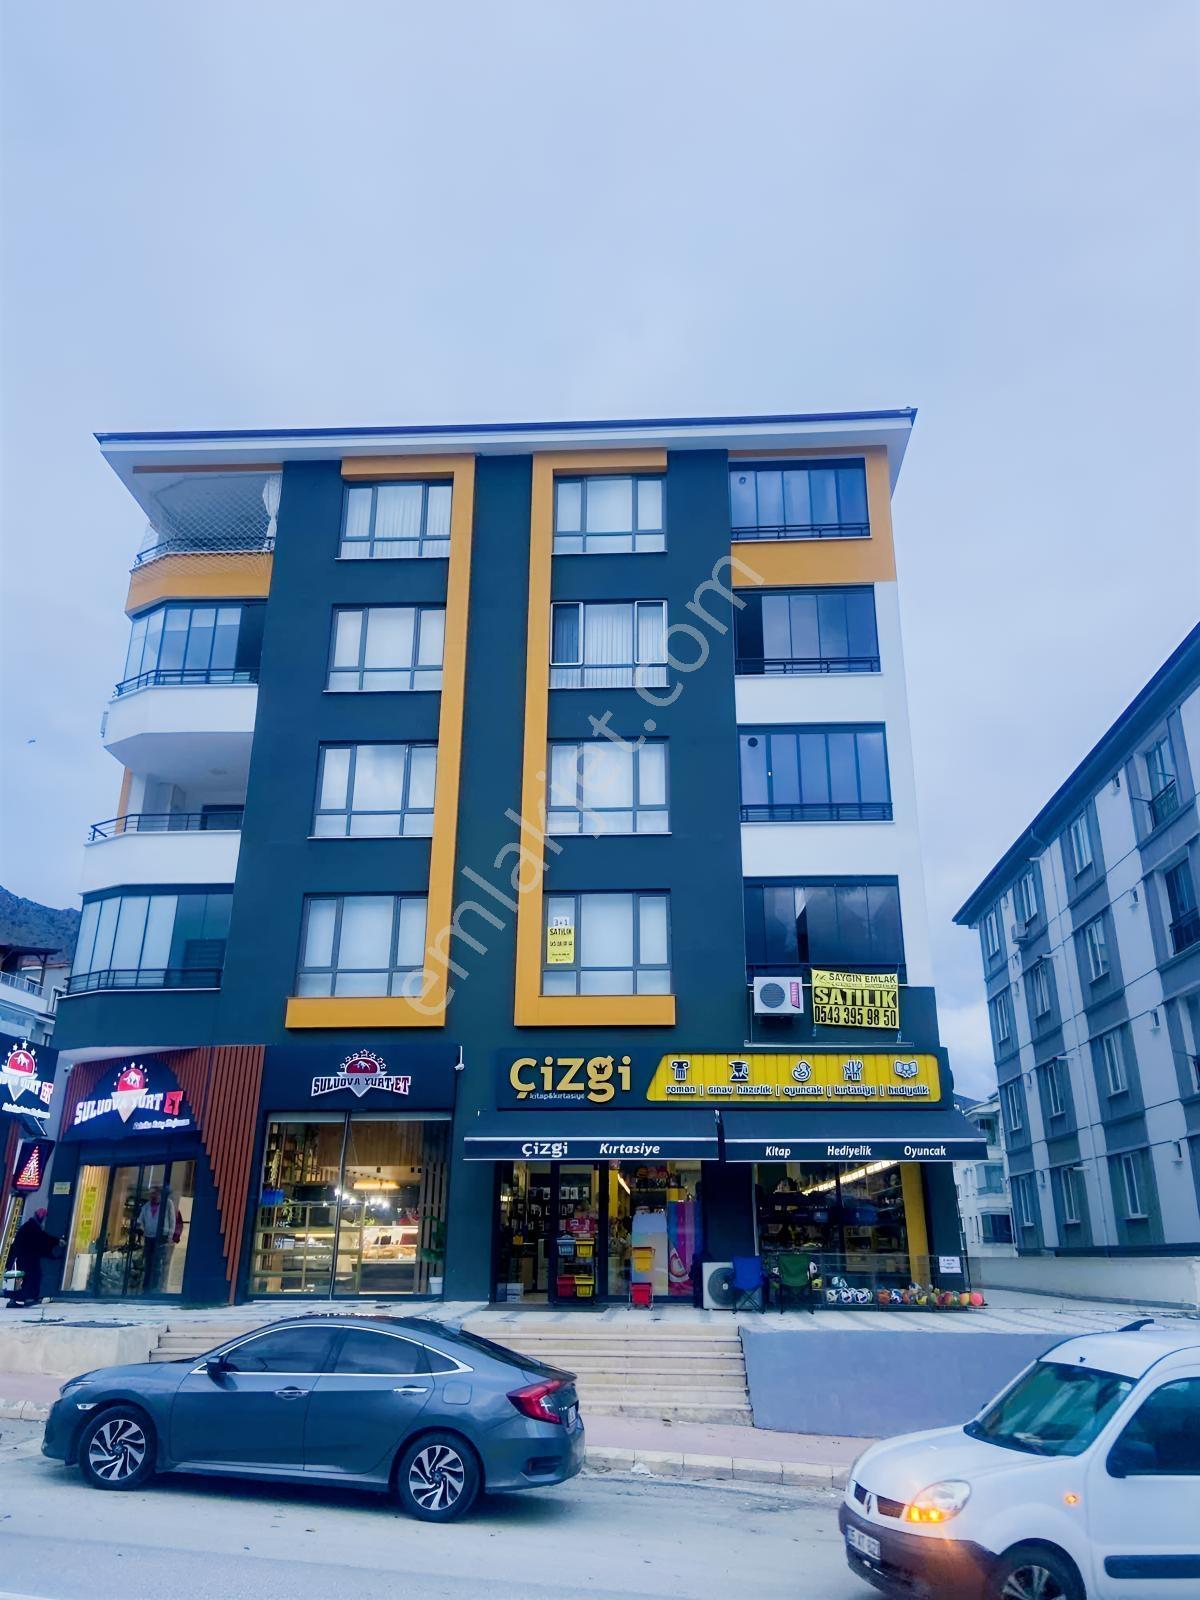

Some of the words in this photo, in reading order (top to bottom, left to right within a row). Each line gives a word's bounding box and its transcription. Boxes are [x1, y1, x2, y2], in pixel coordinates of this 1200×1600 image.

[829, 972, 862, 983] SAYGIN
[865, 975, 896, 984] EMLAK
[814, 986, 897, 1009] SATILIK
[815, 1005, 840, 1023] 0543
[844, 1007, 863, 1025] 395
[867, 1008, 879, 1026] 98
[884, 1009, 896, 1027] 50
[312, 1077, 360, 1096] SULUOVA
[364, 1076, 392, 1091] YURT
[393, 1076, 411, 1095] ET
[666, 1085, 696, 1094] roman
[783, 1085, 823, 1096] oyuncak
[74, 1098, 130, 1125] SULUOV
[765, 1146, 791, 1158] Kitap
[827, 1145, 872, 1158] Hediyelik
[904, 1145, 946, 1158] Oyuncak
